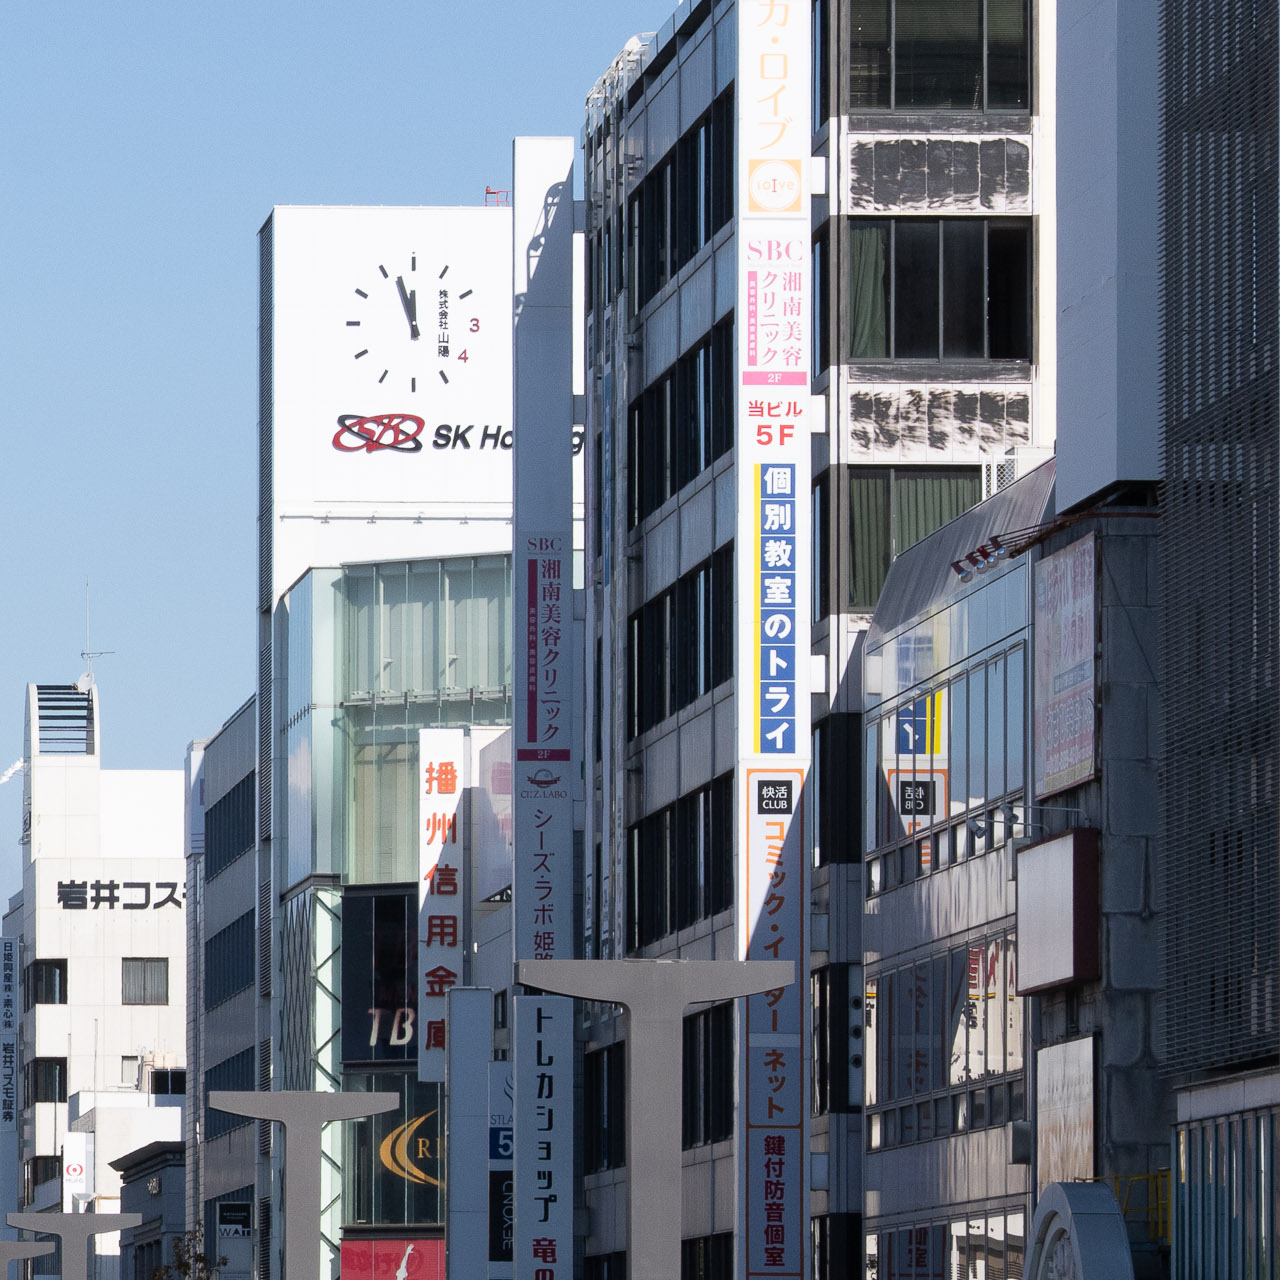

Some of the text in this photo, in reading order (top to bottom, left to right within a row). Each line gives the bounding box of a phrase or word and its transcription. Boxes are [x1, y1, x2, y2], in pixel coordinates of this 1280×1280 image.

[747, 240, 804, 262] SBC
[438, 289, 449, 330] 株式会社
[760, 271, 780, 367] クリニック
[782, 271, 803, 366] 湘南美容
[468, 317, 480, 334] 3
[457, 348, 469, 364] 4
[767, 373, 783, 385] 2F
[747, 401, 804, 420] 当ビル
[432, 425, 471, 451] SK
[756, 424, 795, 446] 5F
[528, 537, 562, 552] SBC
[764, 465, 793, 751] 個別教室のトライ
[540, 559, 562, 742] 湘南美容クリニック
[537, 750, 551, 759] 2F
[762, 786, 788, 799] 快活
[762, 800, 788, 810] CLUB
[57, 879, 186, 910] 岩井コス
[426, 761, 458, 1051] 播州信用金庫
[2, 1042, 15, 1122] 岩井コスモ証券
[536, 1007, 558, 1223] トレカショップ
[763, 1134, 786, 1267] 鍵付防音個室
